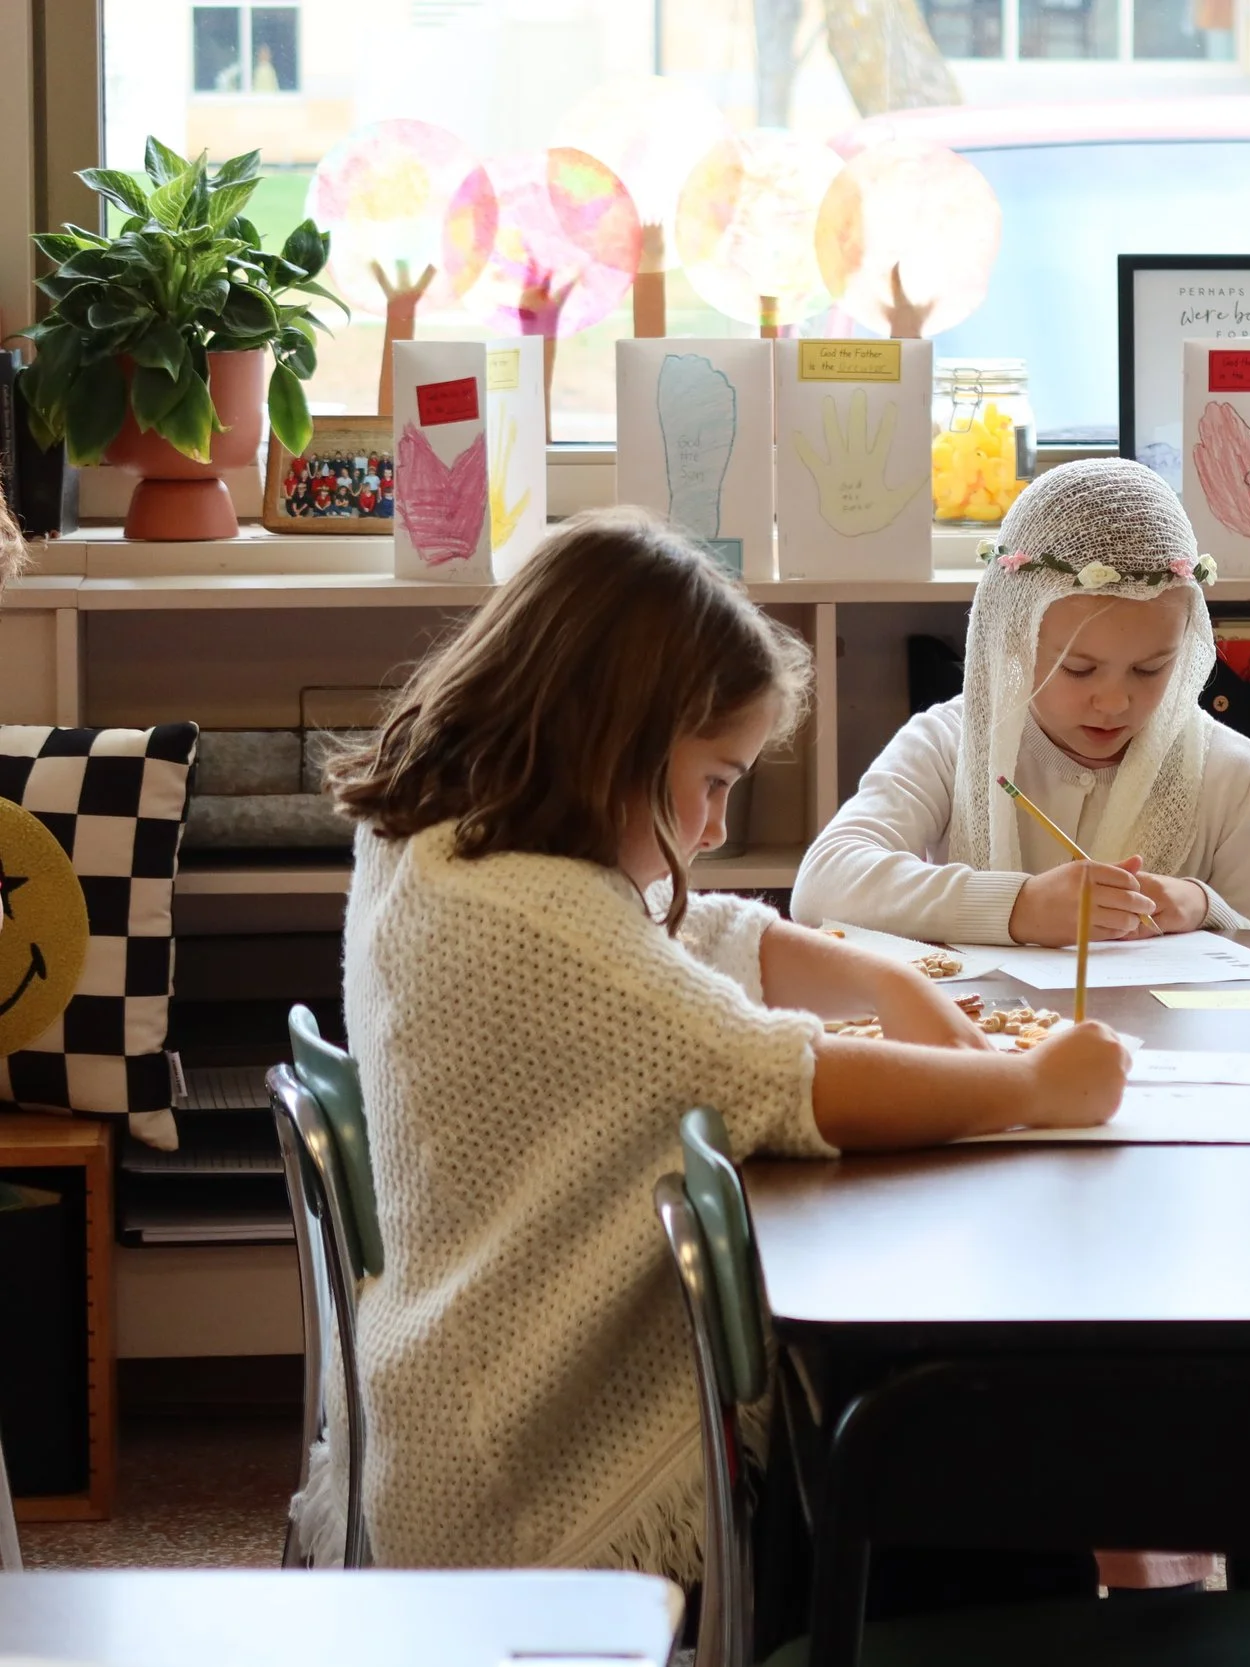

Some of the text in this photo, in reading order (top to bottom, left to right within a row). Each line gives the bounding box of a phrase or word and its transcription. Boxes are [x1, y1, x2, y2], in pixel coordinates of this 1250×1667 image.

[1179, 287, 1245, 297] PERHAPS
[821, 347, 882, 359] God the Father
[822, 360, 834, 370] the
